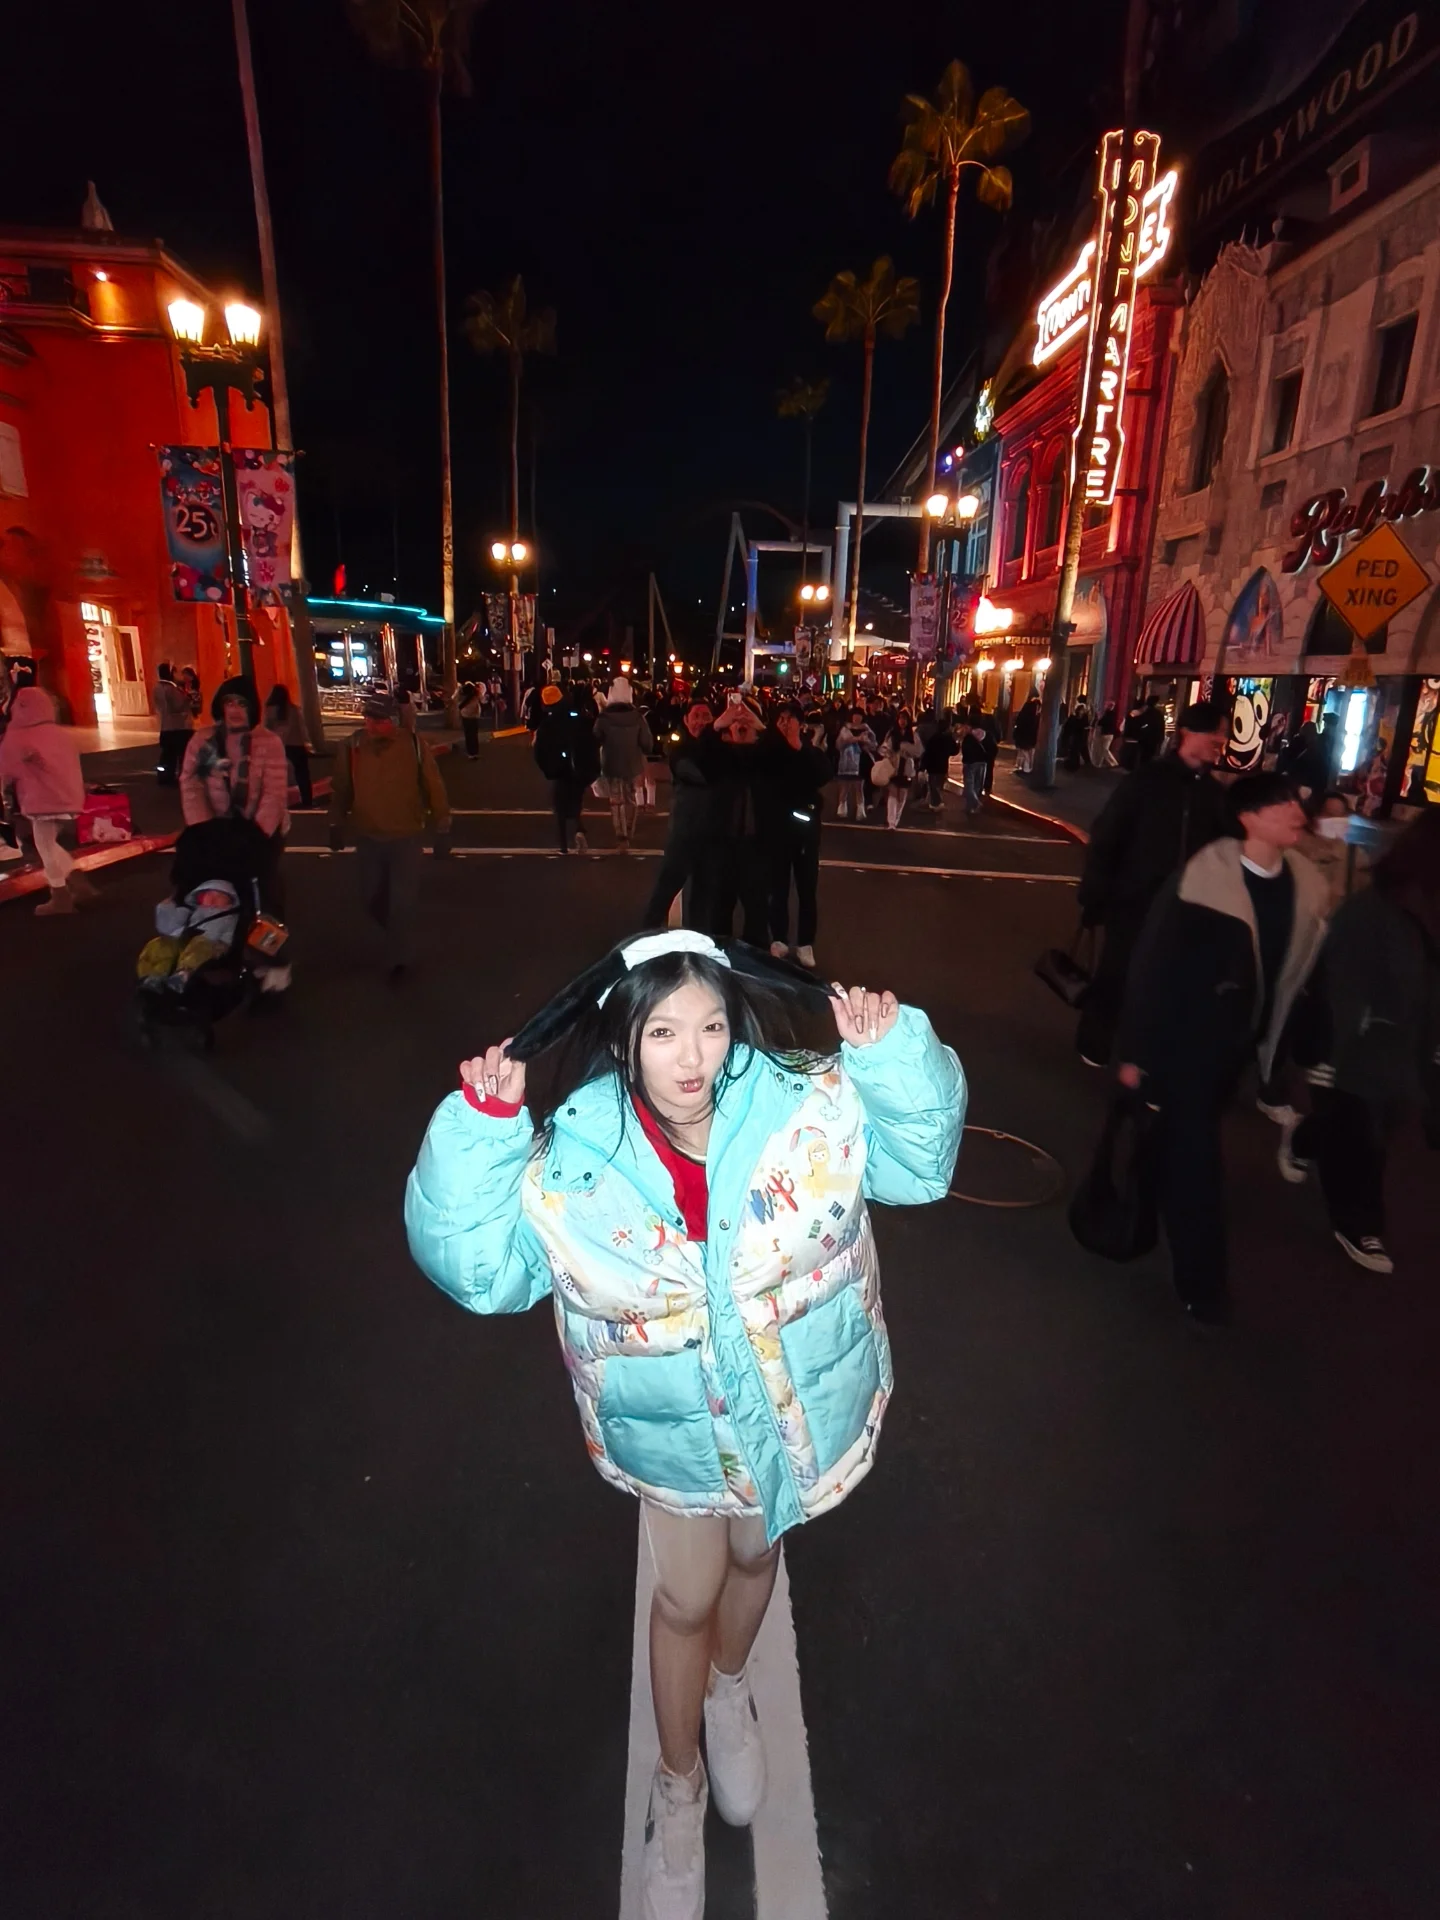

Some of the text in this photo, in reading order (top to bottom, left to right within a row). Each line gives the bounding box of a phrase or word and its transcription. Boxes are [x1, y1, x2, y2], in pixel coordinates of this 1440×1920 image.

[1195, 11, 1419, 221] HOLLYWOOD
[1355, 559, 1399, 578] PED
[1344, 587, 1398, 606] XING
